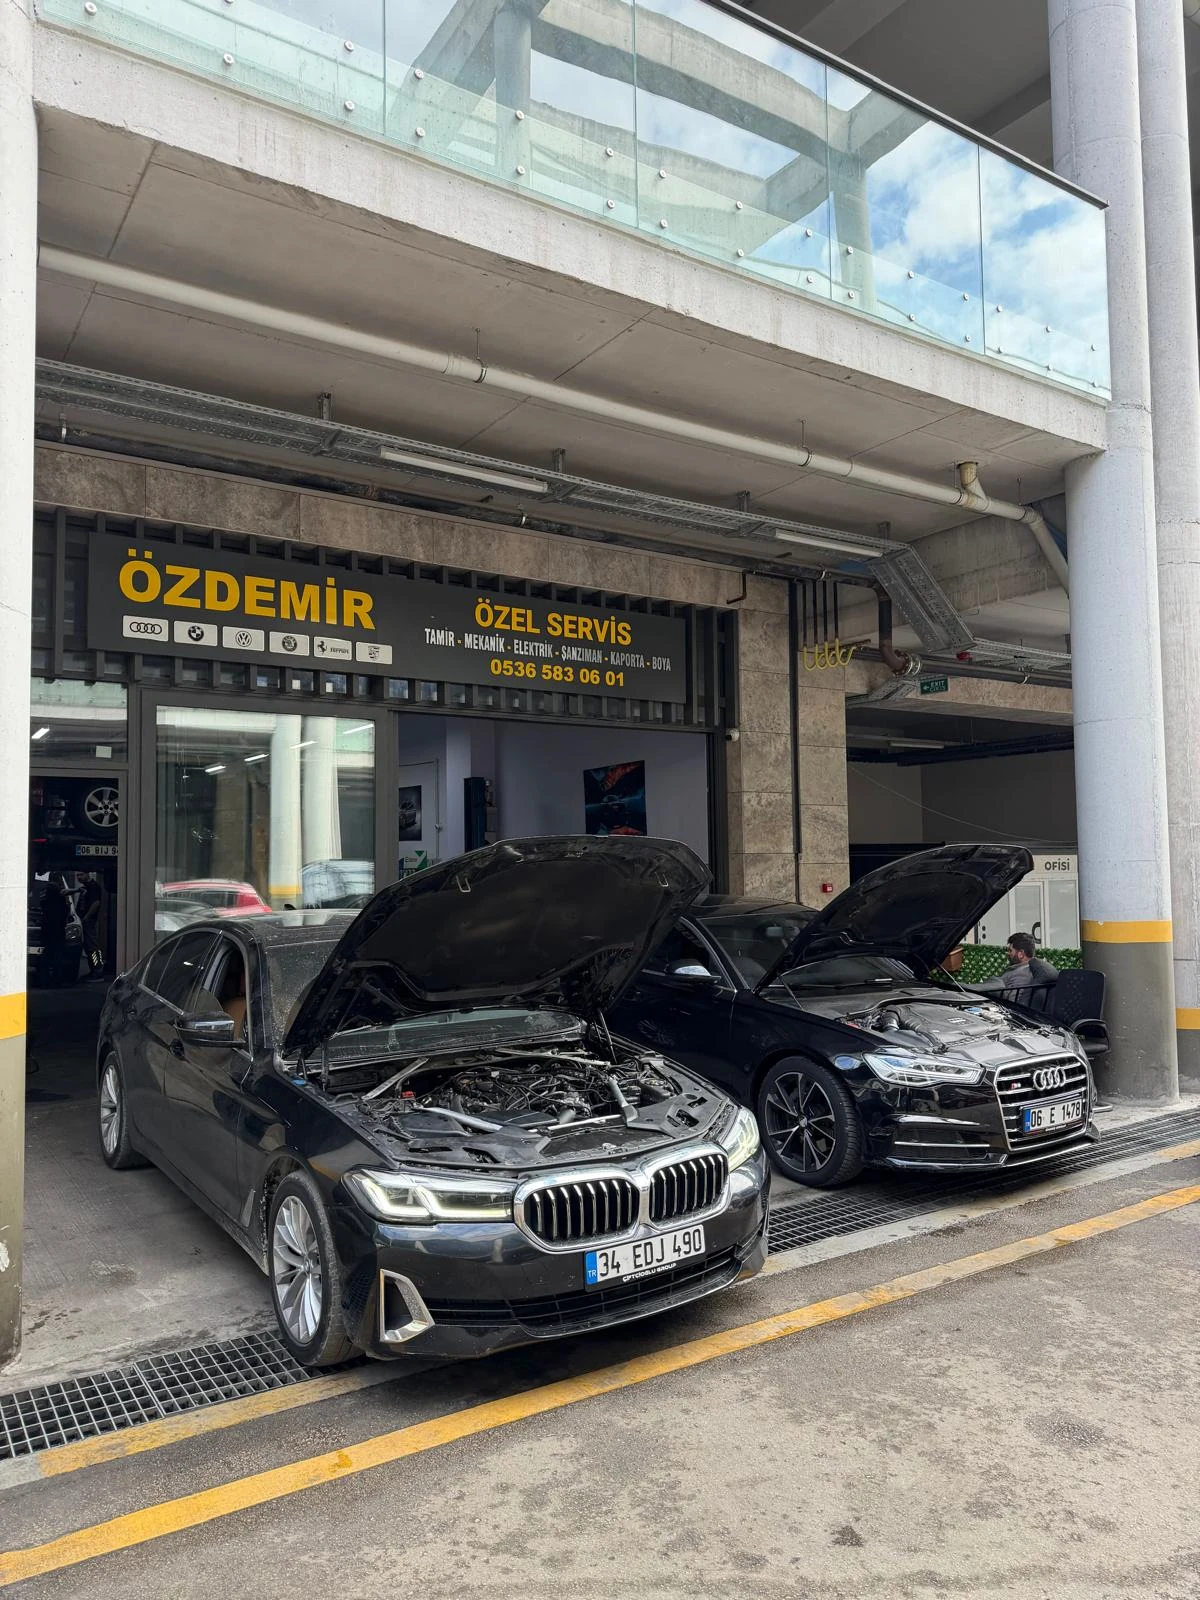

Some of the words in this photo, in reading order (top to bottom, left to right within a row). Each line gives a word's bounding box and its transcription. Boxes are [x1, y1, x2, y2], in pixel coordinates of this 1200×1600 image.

[119, 548, 376, 630] ÖZDEMİR
[475, 597, 541, 634] ÖZEL
[546, 612, 632, 646] SERVİS
[424, 627, 455, 647] TAMİR
[464, 633, 505, 653] MEKANİK
[513, 639, 553, 658] ELEKTRİK
[561, 645, 602, 664] ŞANZIMAN
[610, 651, 645, 668] KAPORTA
[652, 656, 672, 672] BOYA
[490, 659, 537, 679] 0536
[541, 664, 574, 682] 583
[579, 668, 600, 685] 06
[605, 671, 624, 686] 01
[930, 681, 945, 689] EXIT
[1044, 857, 1070, 871] OFİSİ
[1030, 1110, 1042, 1128] 06
[1049, 1106, 1056, 1124] E
[1061, 1101, 1081, 1120] 1478
[599, 1250, 621, 1277] 34
[632, 1238, 665, 1269] EDJ
[672, 1228, 702, 1257] 490
[588, 1269, 597, 1277] TR
